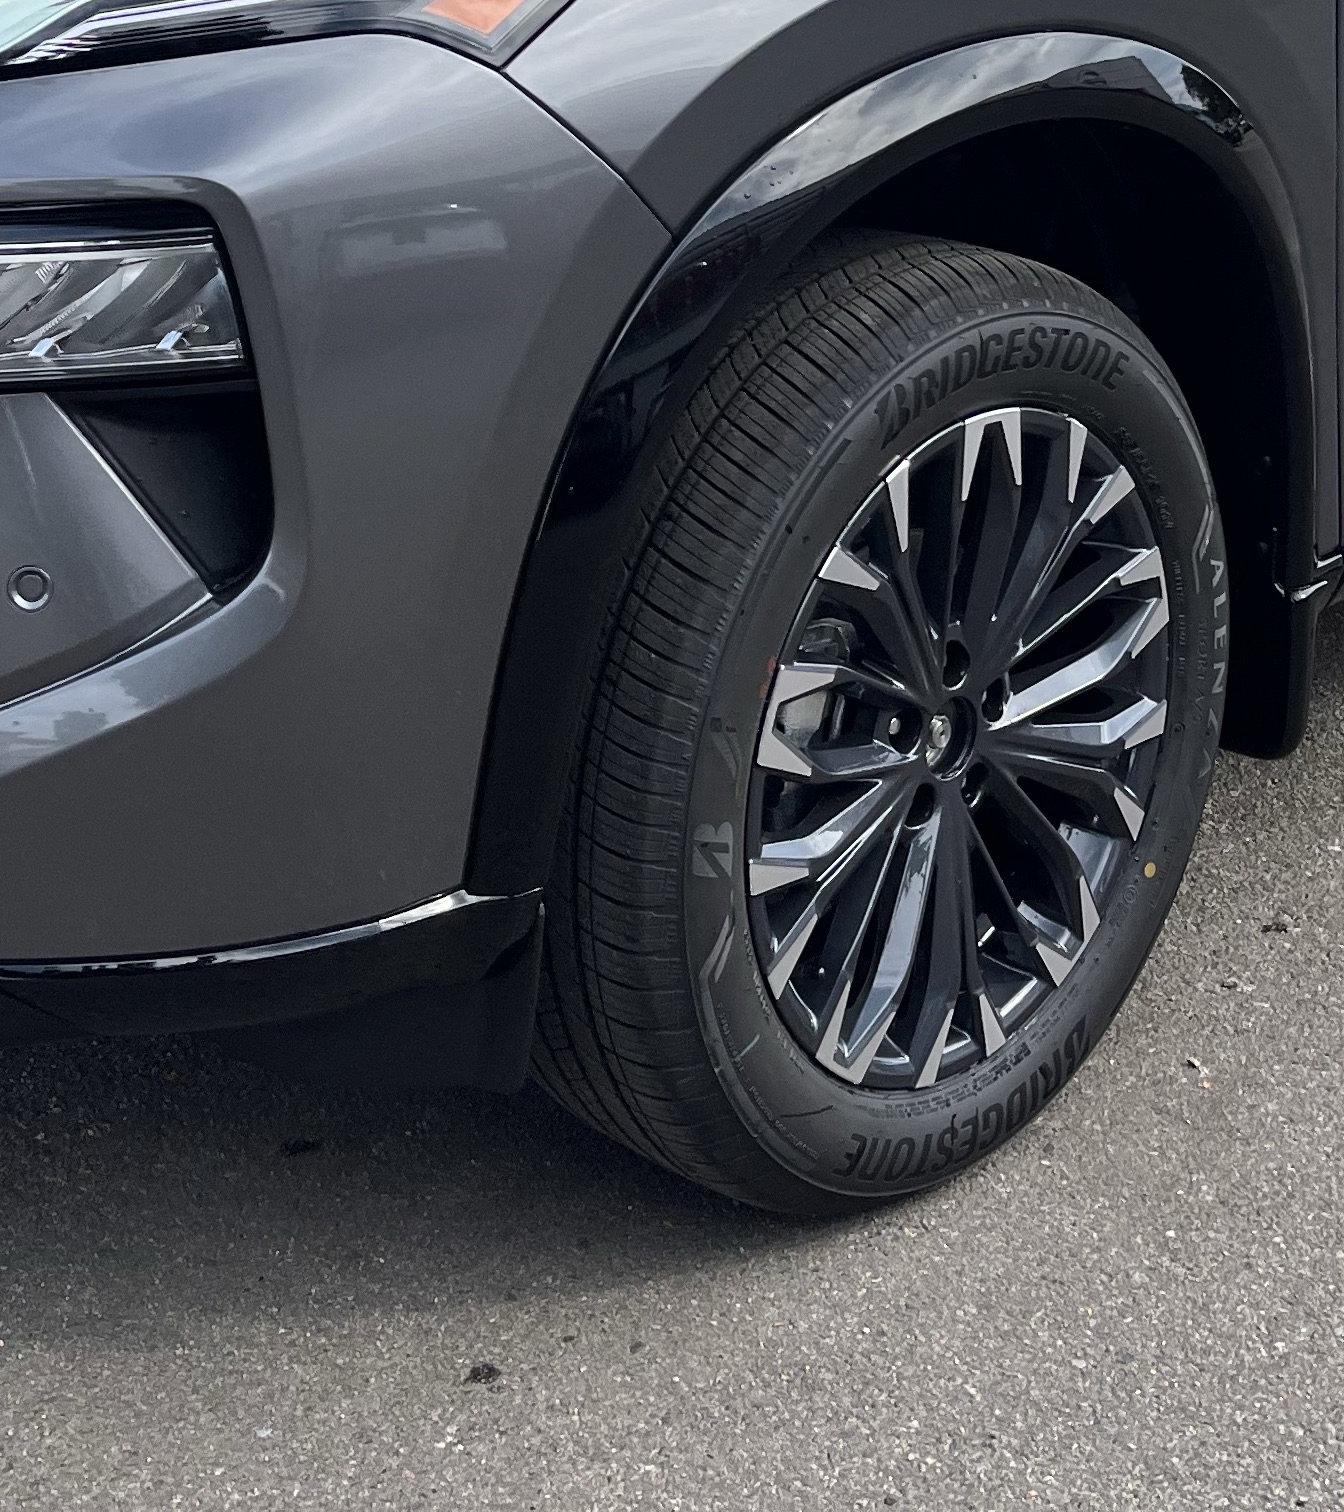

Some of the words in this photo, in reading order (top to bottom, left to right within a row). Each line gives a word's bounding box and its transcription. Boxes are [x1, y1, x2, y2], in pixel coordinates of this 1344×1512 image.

[874, 325, 1130, 451] BRIDGESTONE
[1197, 558, 1227, 779] ALENZA
[832, 1014, 1092, 1182] BRIDGESTONE
